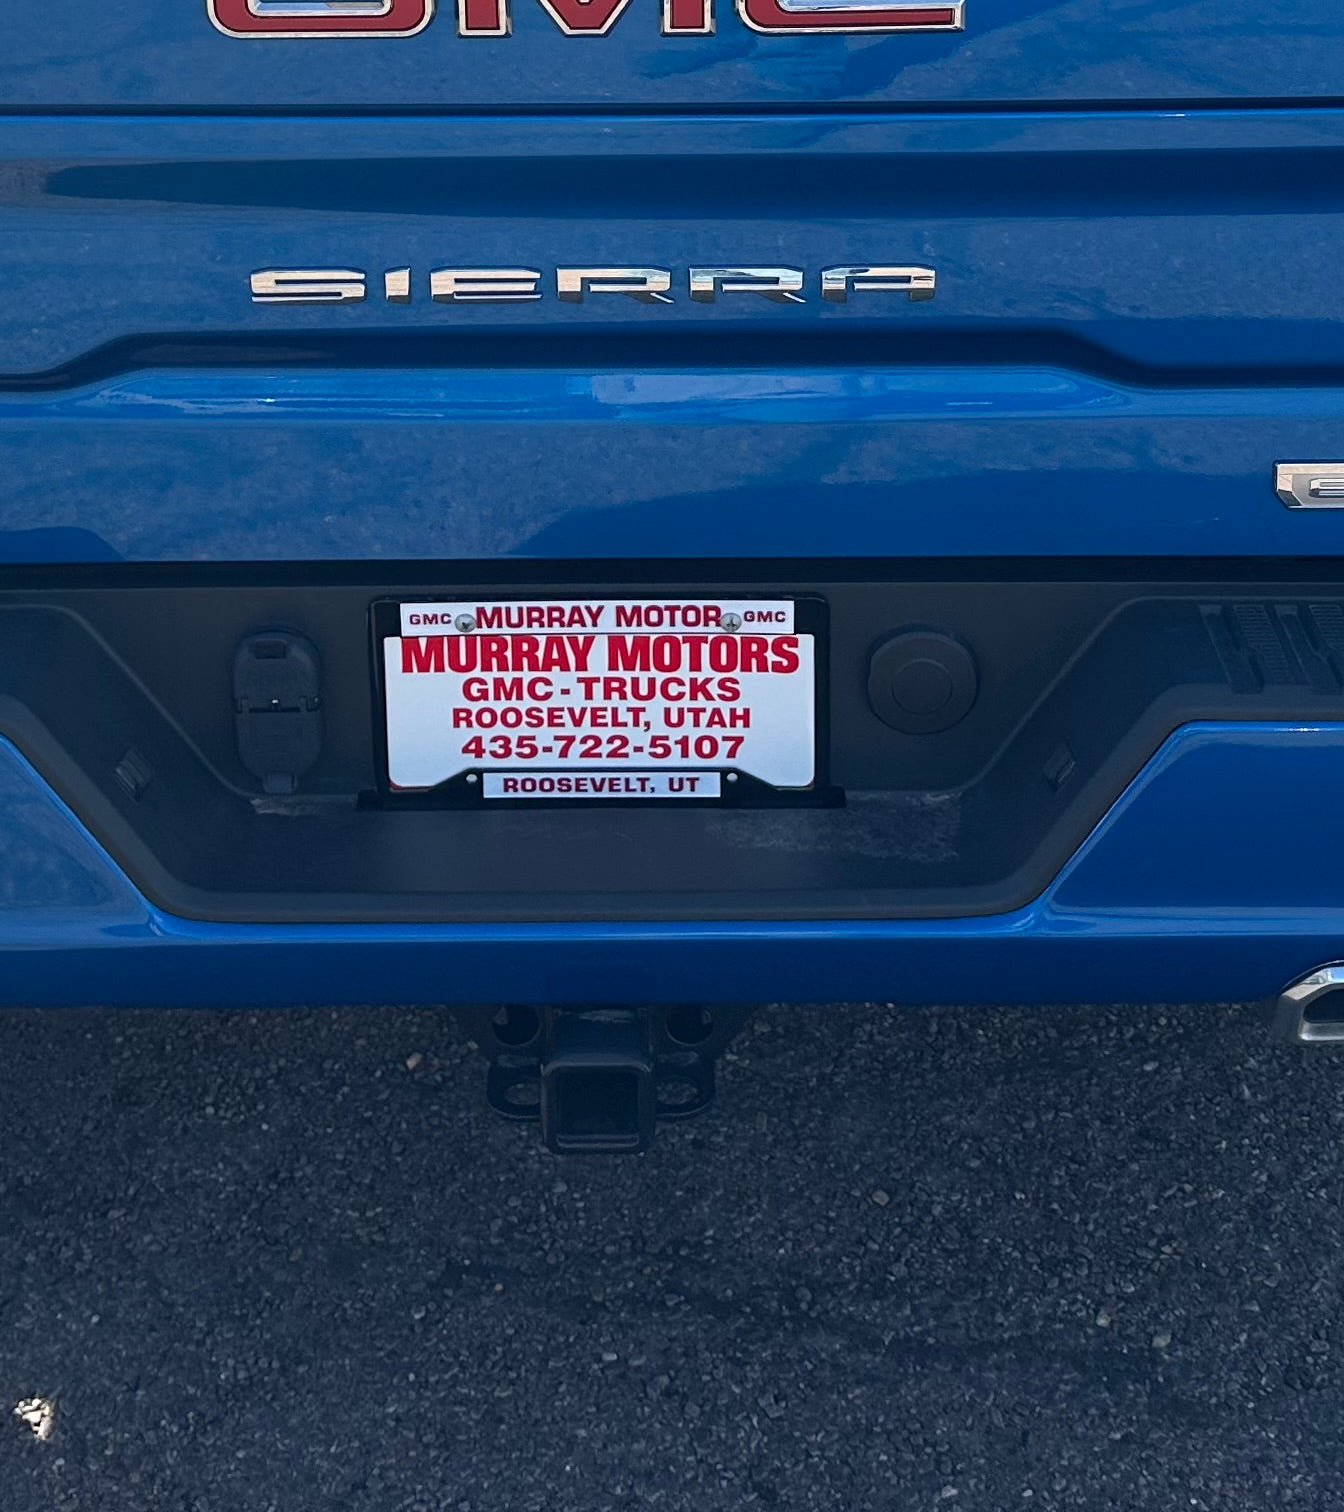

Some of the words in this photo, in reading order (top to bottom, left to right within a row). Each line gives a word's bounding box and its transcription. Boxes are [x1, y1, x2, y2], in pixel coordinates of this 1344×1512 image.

[249, 266, 938, 305] SIERRA
[409, 613, 452, 626] GMC
[475, 604, 605, 629] MURRAY
[615, 604, 722, 628] MOTOR
[743, 610, 787, 623] GMC
[401, 635, 596, 674] MURRAY
[607, 634, 800, 674] MOTORS
[451, 706, 652, 733] ROOSEVELT,
[662, 706, 751, 729] UTAH
[461, 734, 746, 760] 435-722-5107
[502, 776, 656, 794] ROOSEVELT,
[667, 776, 700, 793] UT
